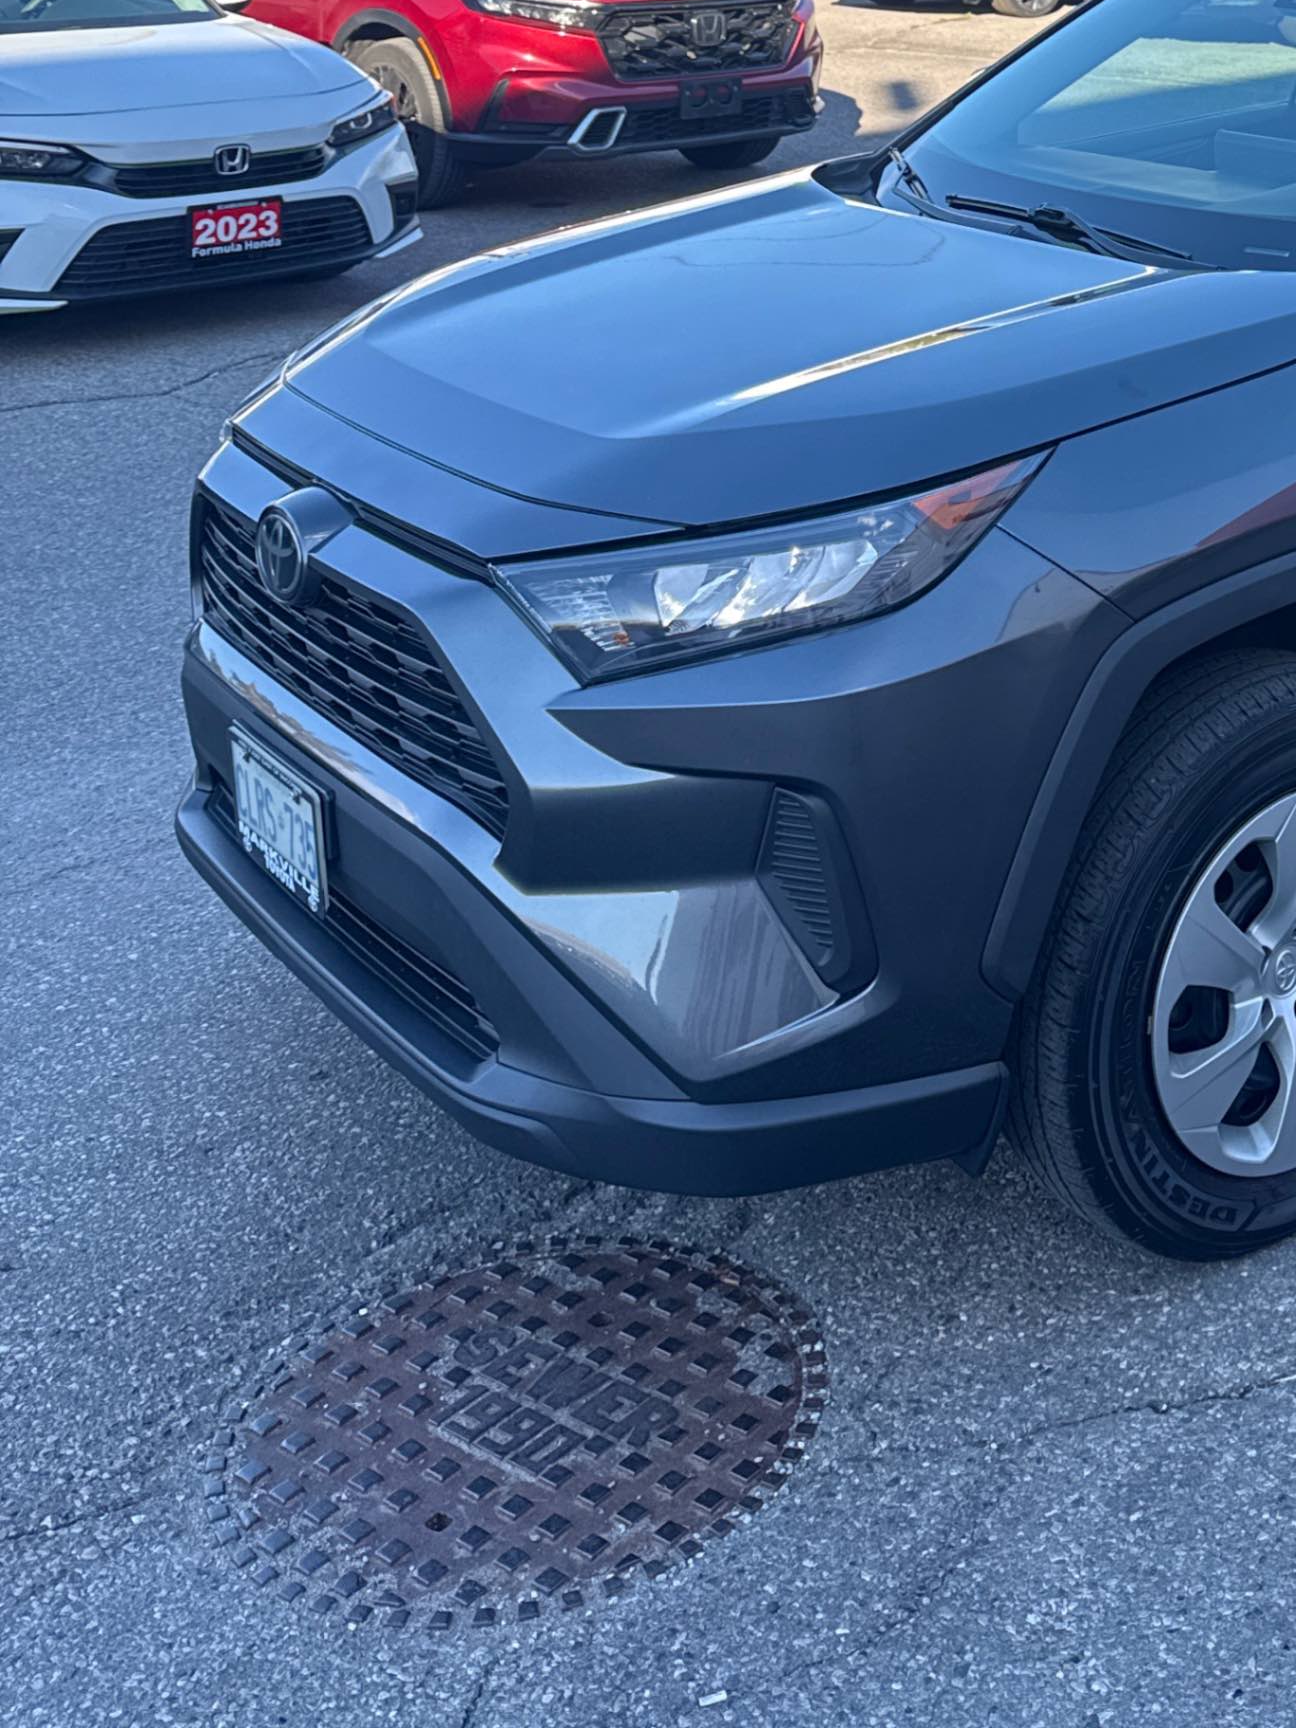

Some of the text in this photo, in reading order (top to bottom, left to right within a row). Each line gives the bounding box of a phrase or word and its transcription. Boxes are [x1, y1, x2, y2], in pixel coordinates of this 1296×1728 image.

[192, 238, 281, 258] Formula Honda
[195, 210, 278, 245] 2023
[238, 820, 320, 903] MARKVILLE
[264, 854, 296, 893] TOYOTA
[453, 1326, 680, 1448] SEWER
[430, 1384, 587, 1473] 1990
